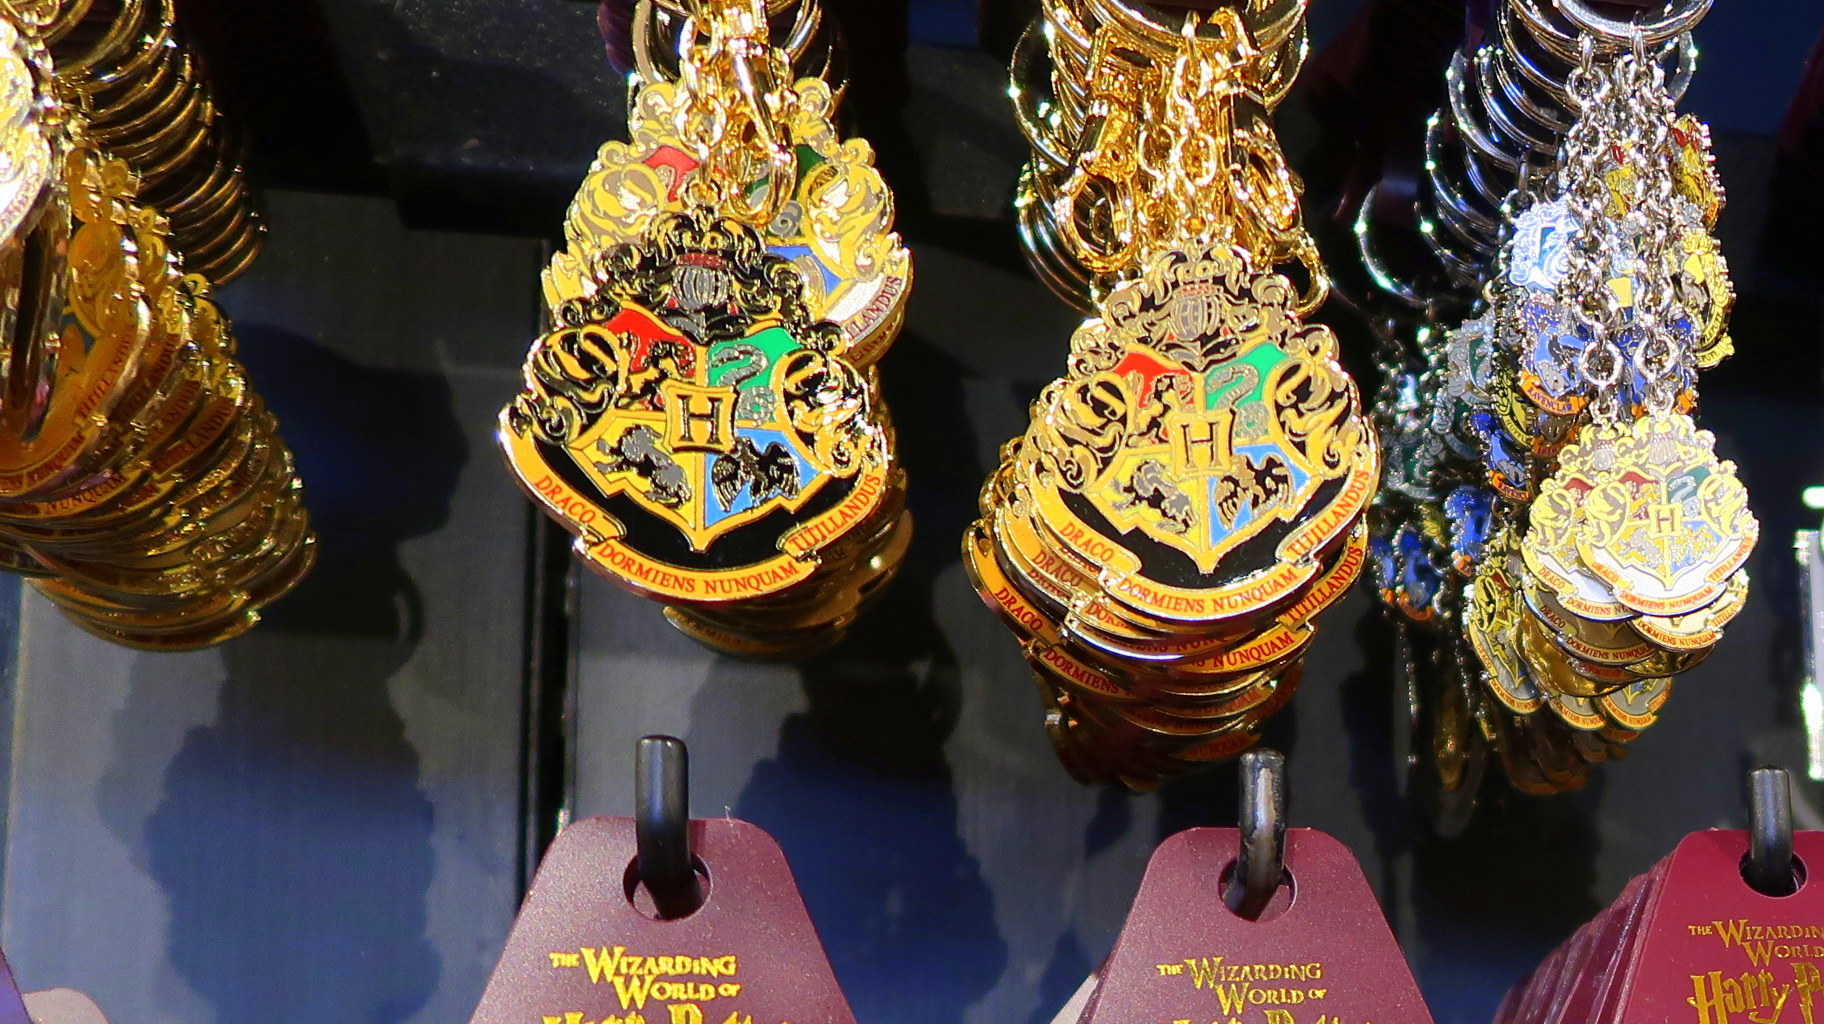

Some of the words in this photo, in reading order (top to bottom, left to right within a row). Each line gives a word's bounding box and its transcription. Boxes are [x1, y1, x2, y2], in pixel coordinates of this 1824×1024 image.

[677, 393, 721, 444] H
[1527, 388, 1573, 412] RAVENCLAW
[1184, 421, 1218, 469] H
[534, 475, 596, 525] DRACO
[598, 542, 696, 594] DORMIENS
[704, 560, 800, 595] NUNQUAM
[789, 474, 883, 552] TITILLANDUS
[1059, 521, 1115, 563] DRACO
[1117, 574, 1205, 614] DORMIENS
[1212, 568, 1299, 613] NUNQUAM
[1286, 468, 1371, 558] TITILLANDUS
[1538, 567, 1566, 589] DRACO
[1566, 596, 1611, 616] DORMIENS
[1592, 561, 1619, 583] DRACO
[994, 586, 1045, 633] DRACO
[1213, 631, 1296, 668] NUNQUAM
[1286, 543, 1364, 625] TITILLANDUS
[1540, 605, 1566, 629] DRACO
[1566, 636, 1609, 660] DORMIENS
[1637, 620, 1677, 646] DORMIENS
[1688, 924, 1712, 936] THE
[549, 951, 580, 968] THE
[580, 945, 737, 984] WIZARDING
[1184, 956, 1322, 989] WIZARDING
[613, 974, 715, 1010] WORLD
[718, 983, 741, 998] OF
[1214, 982, 1305, 1016] WORLD
